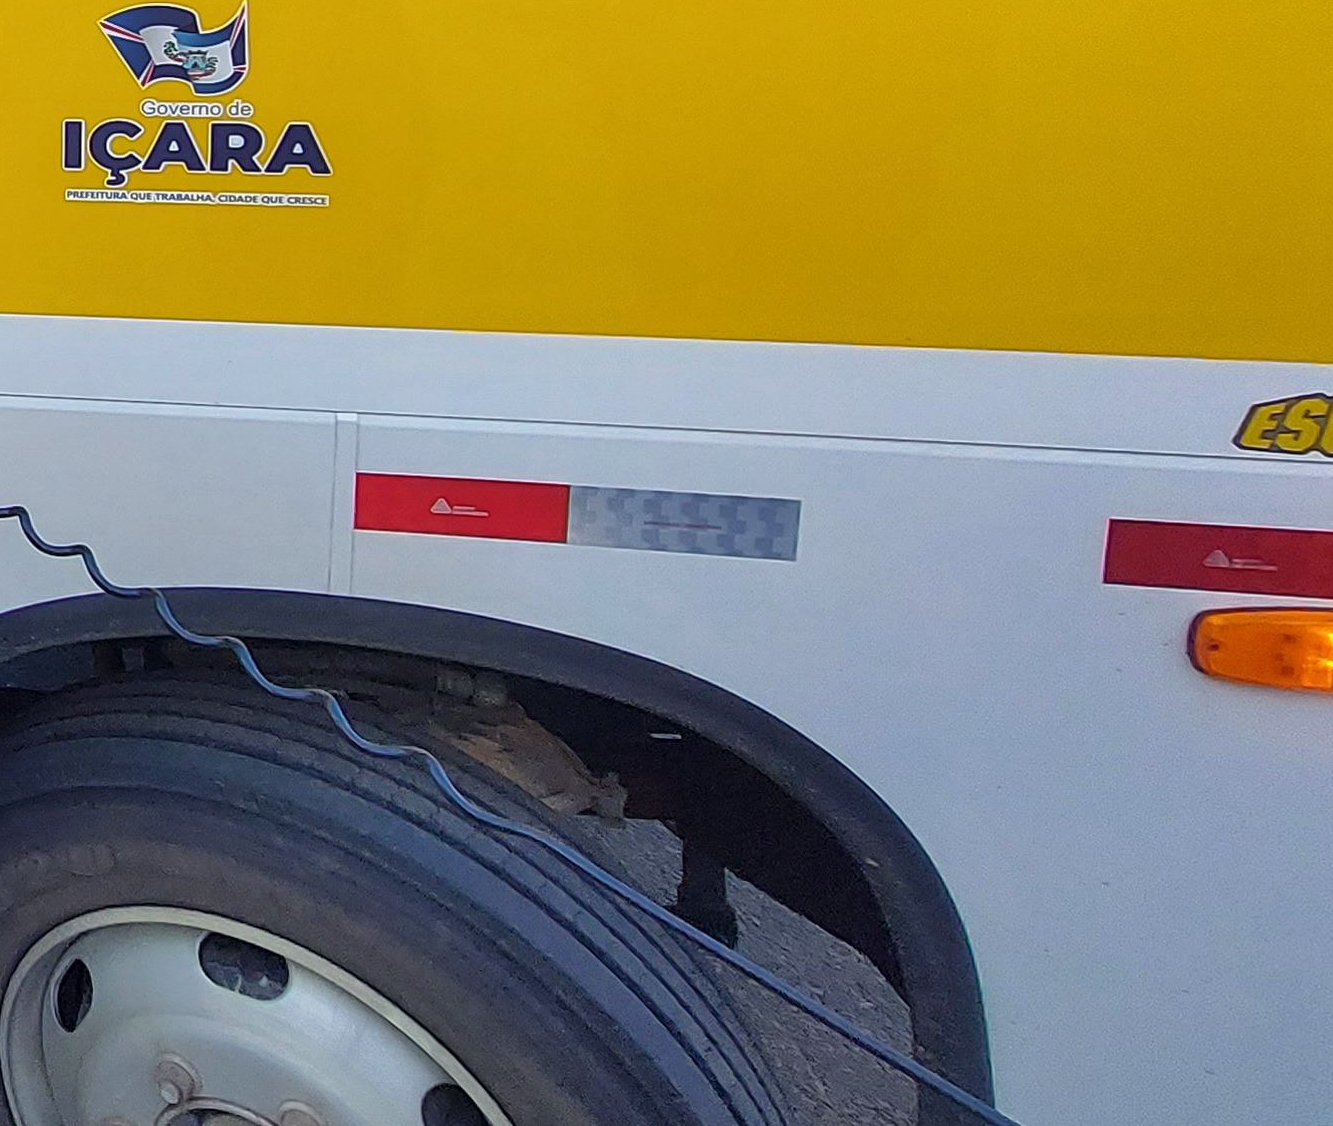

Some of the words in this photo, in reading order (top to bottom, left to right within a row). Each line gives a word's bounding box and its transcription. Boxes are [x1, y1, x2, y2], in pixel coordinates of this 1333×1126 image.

[141, 100, 222, 116] Governo
[229, 101, 252, 116] de
[63, 120, 332, 186] IÇARA
[66, 190, 128, 200] PREFEITURA
[130, 192, 152, 201] QUE
[155, 192, 216, 203] TRABALHA,
[218, 194, 259, 204] CIDADE
[261, 195, 284, 205] QUE
[287, 196, 328, 206] CRESCE
